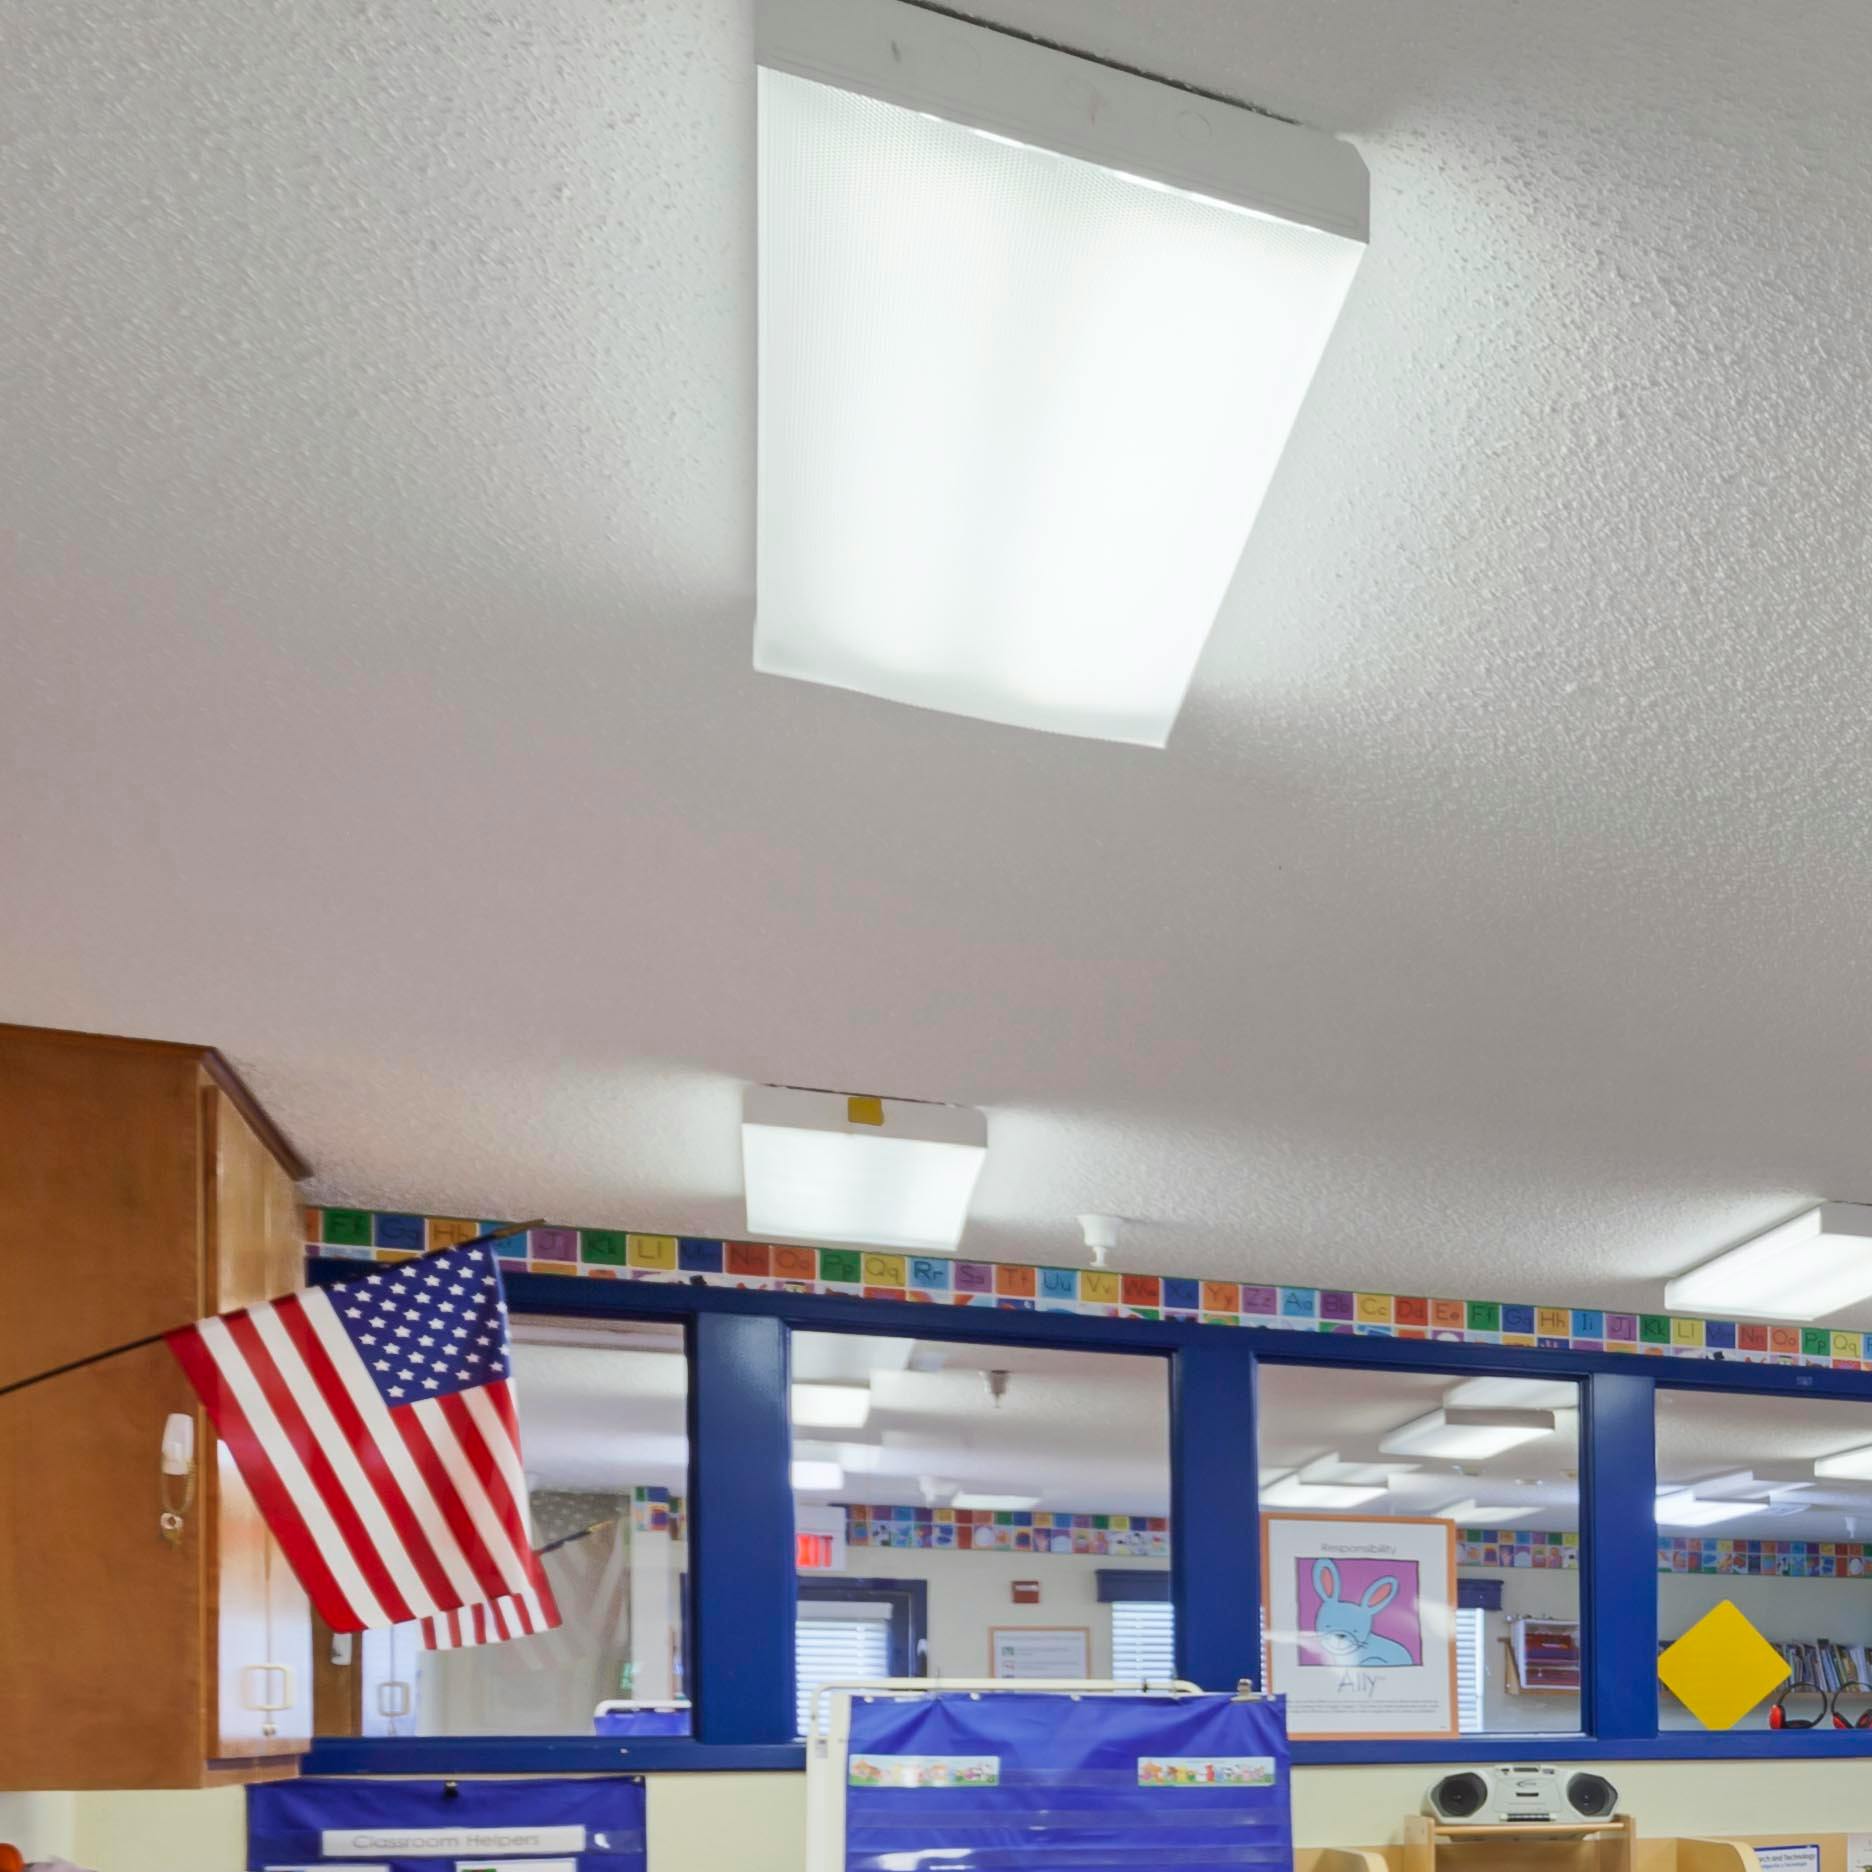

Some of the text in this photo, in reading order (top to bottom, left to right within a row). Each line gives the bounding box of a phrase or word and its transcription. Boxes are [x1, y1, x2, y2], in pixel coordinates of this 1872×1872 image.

[1338, 1673, 1377, 1697] Ally
[351, 1834, 540, 1849] Classroom Helpers
